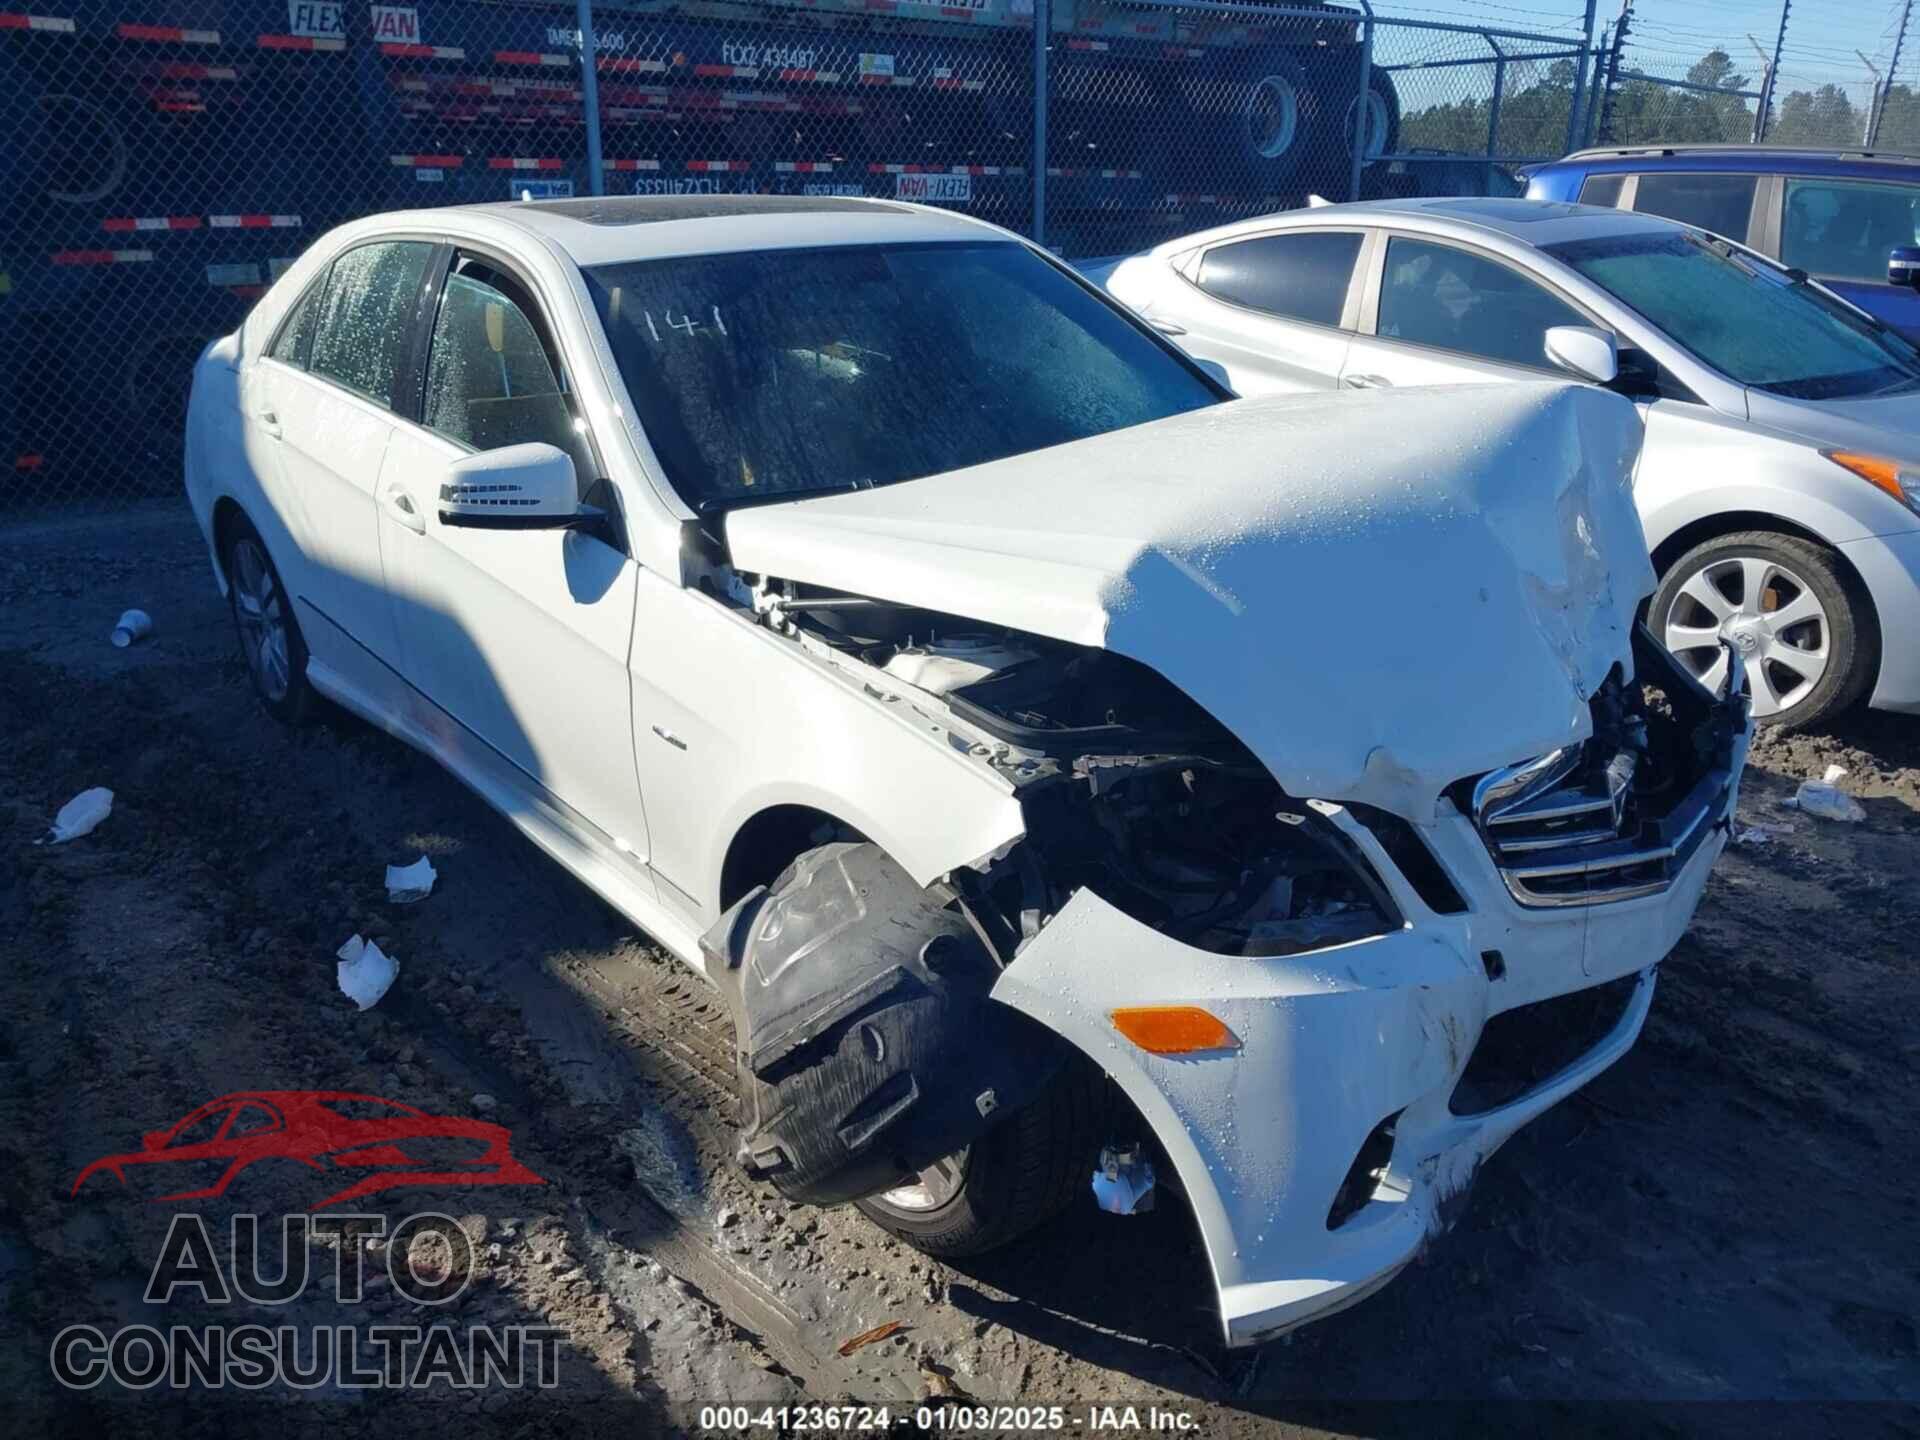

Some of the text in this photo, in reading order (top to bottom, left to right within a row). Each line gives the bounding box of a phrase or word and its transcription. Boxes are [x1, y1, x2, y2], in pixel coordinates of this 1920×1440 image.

[370, 11, 416, 38] VAN
[722, 43, 757, 66] FLXZ
[900, 177, 968, 198] FLEXI-VAN
[643, 305, 728, 342] 141
